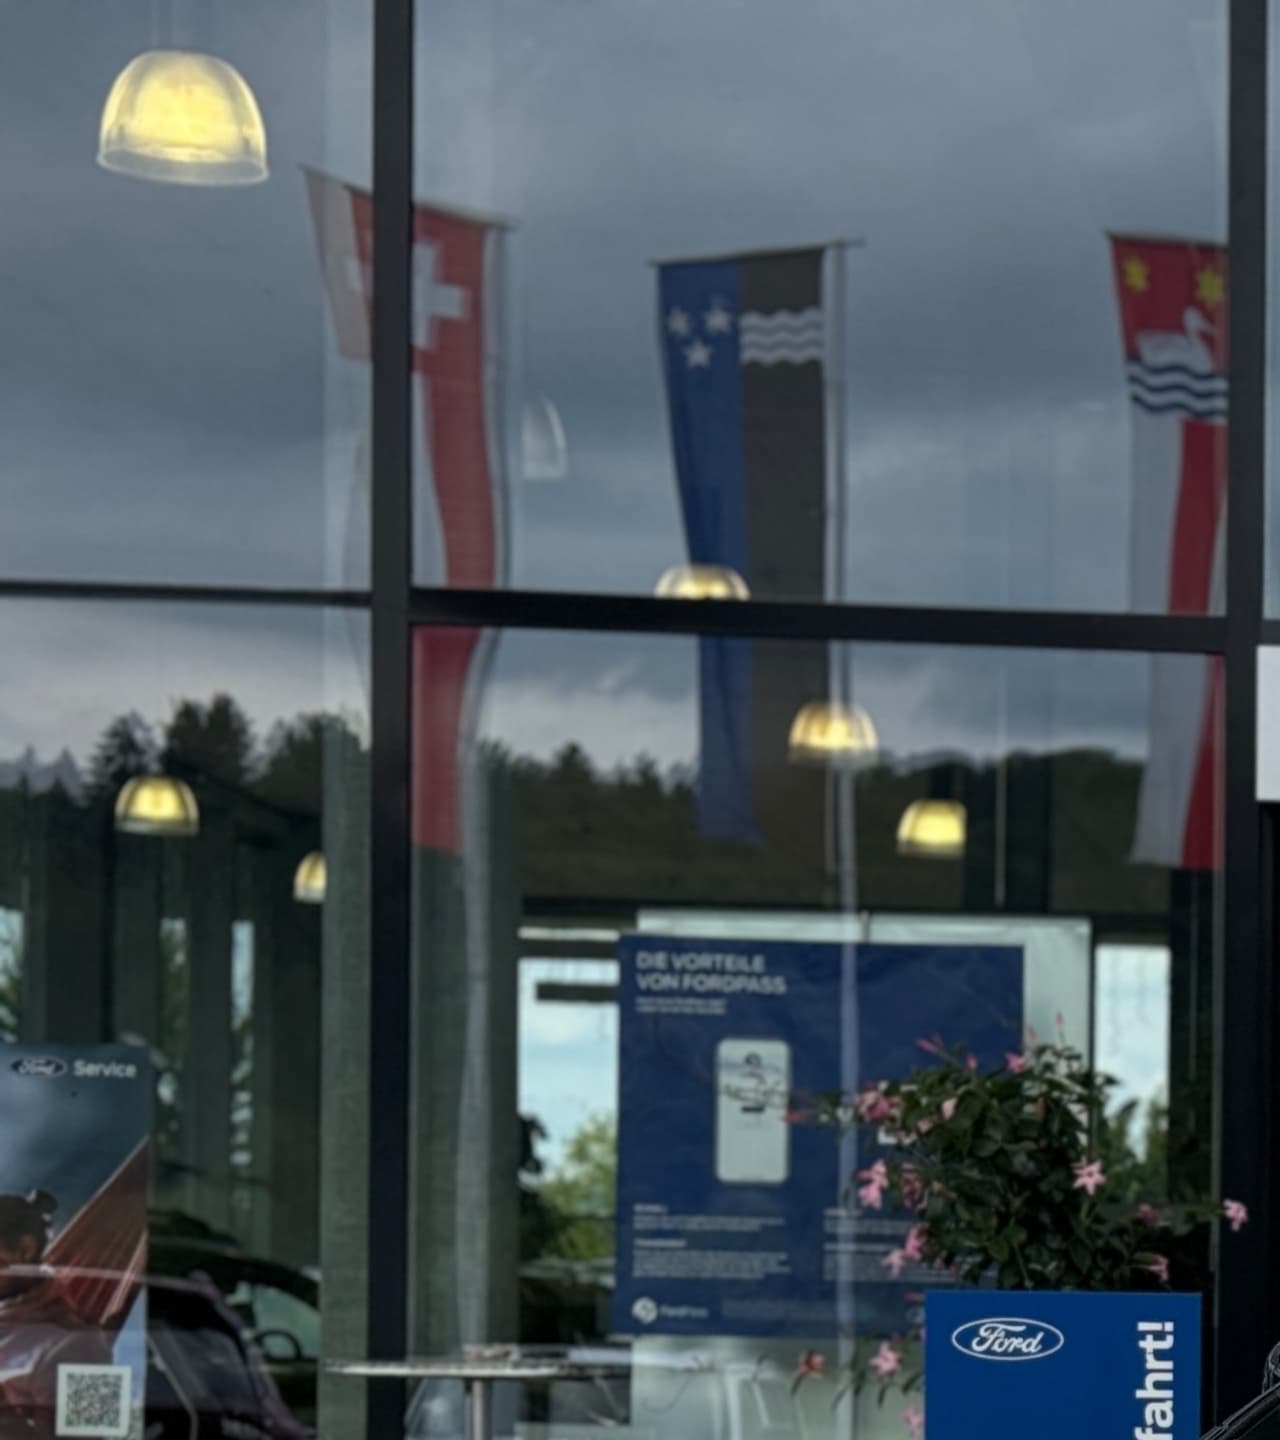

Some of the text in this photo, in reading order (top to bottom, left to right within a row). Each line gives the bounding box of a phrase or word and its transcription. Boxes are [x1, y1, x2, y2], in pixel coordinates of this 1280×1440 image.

[636, 952, 766, 973] DIE VORTEILE
[636, 973, 788, 994] VON FORDPASS
[74, 1060, 136, 1078] Service
[970, 1322, 1046, 1354] Ford
